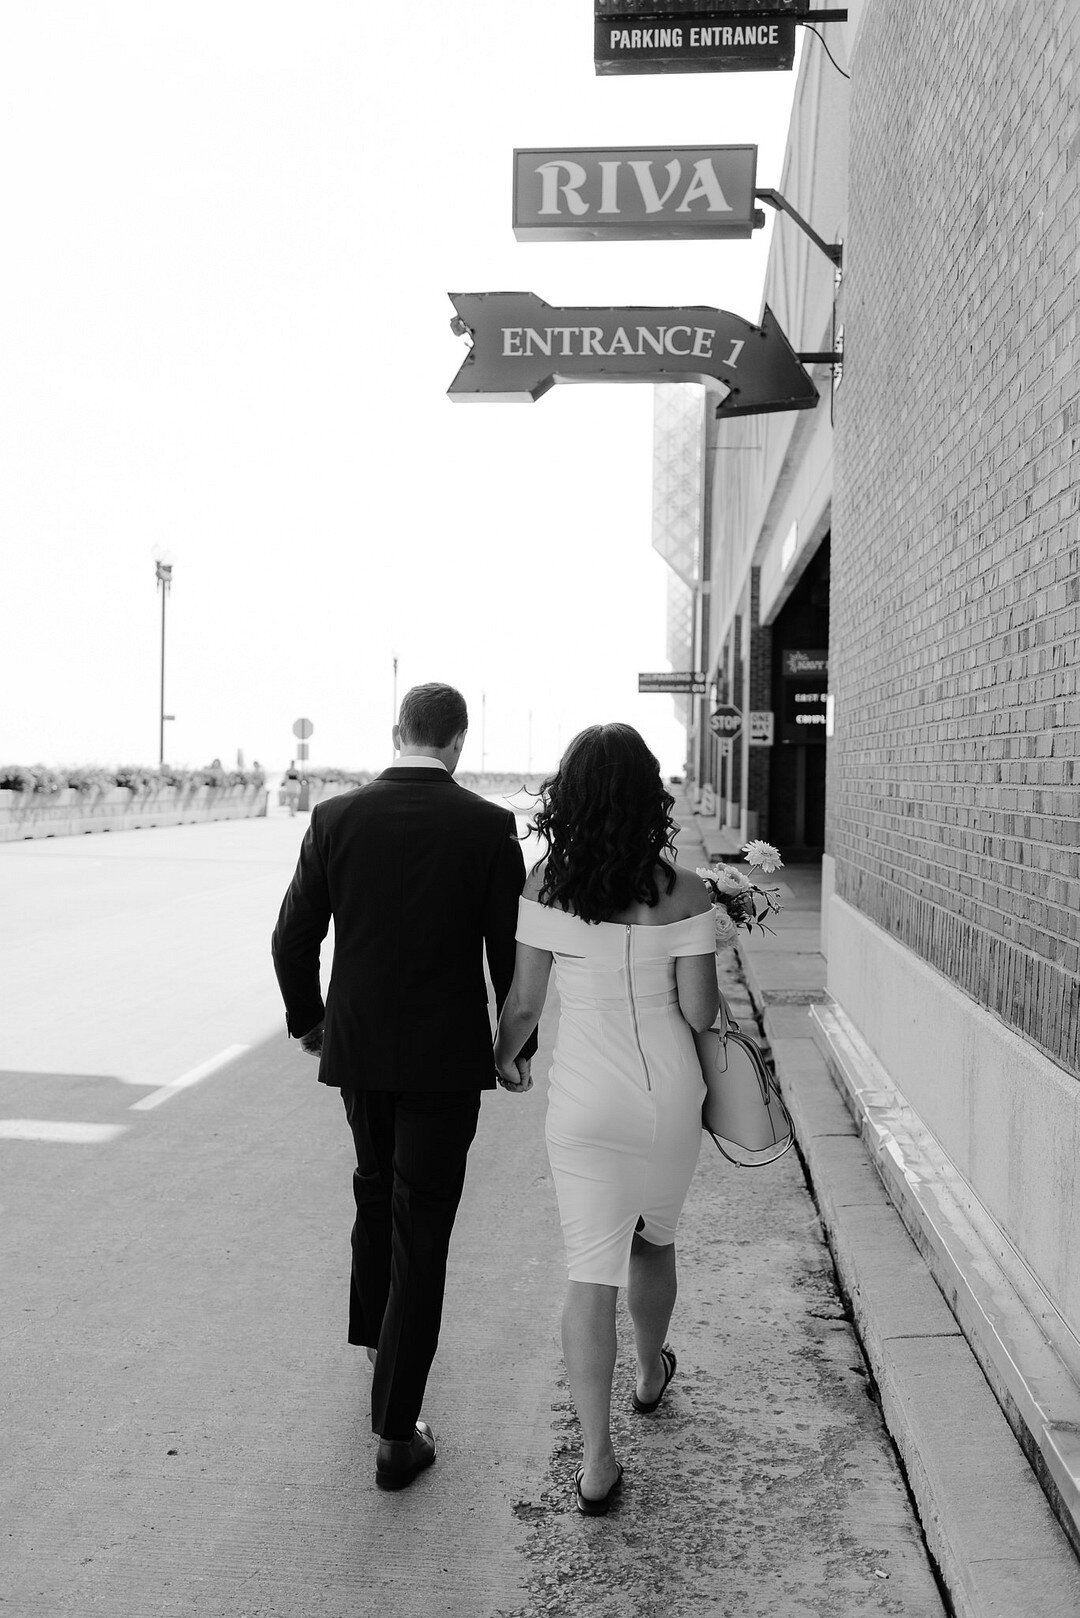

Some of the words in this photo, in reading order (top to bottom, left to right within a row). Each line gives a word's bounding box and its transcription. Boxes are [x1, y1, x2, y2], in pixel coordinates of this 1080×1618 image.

[610, 28, 683, 49] PARKING
[690, 25, 779, 47] ENTRANCE
[535, 158, 732, 216] RIVA
[501, 326, 715, 358] ENTRANCE
[722, 339, 745, 369] 1
[711, 715, 741, 731] STOP
